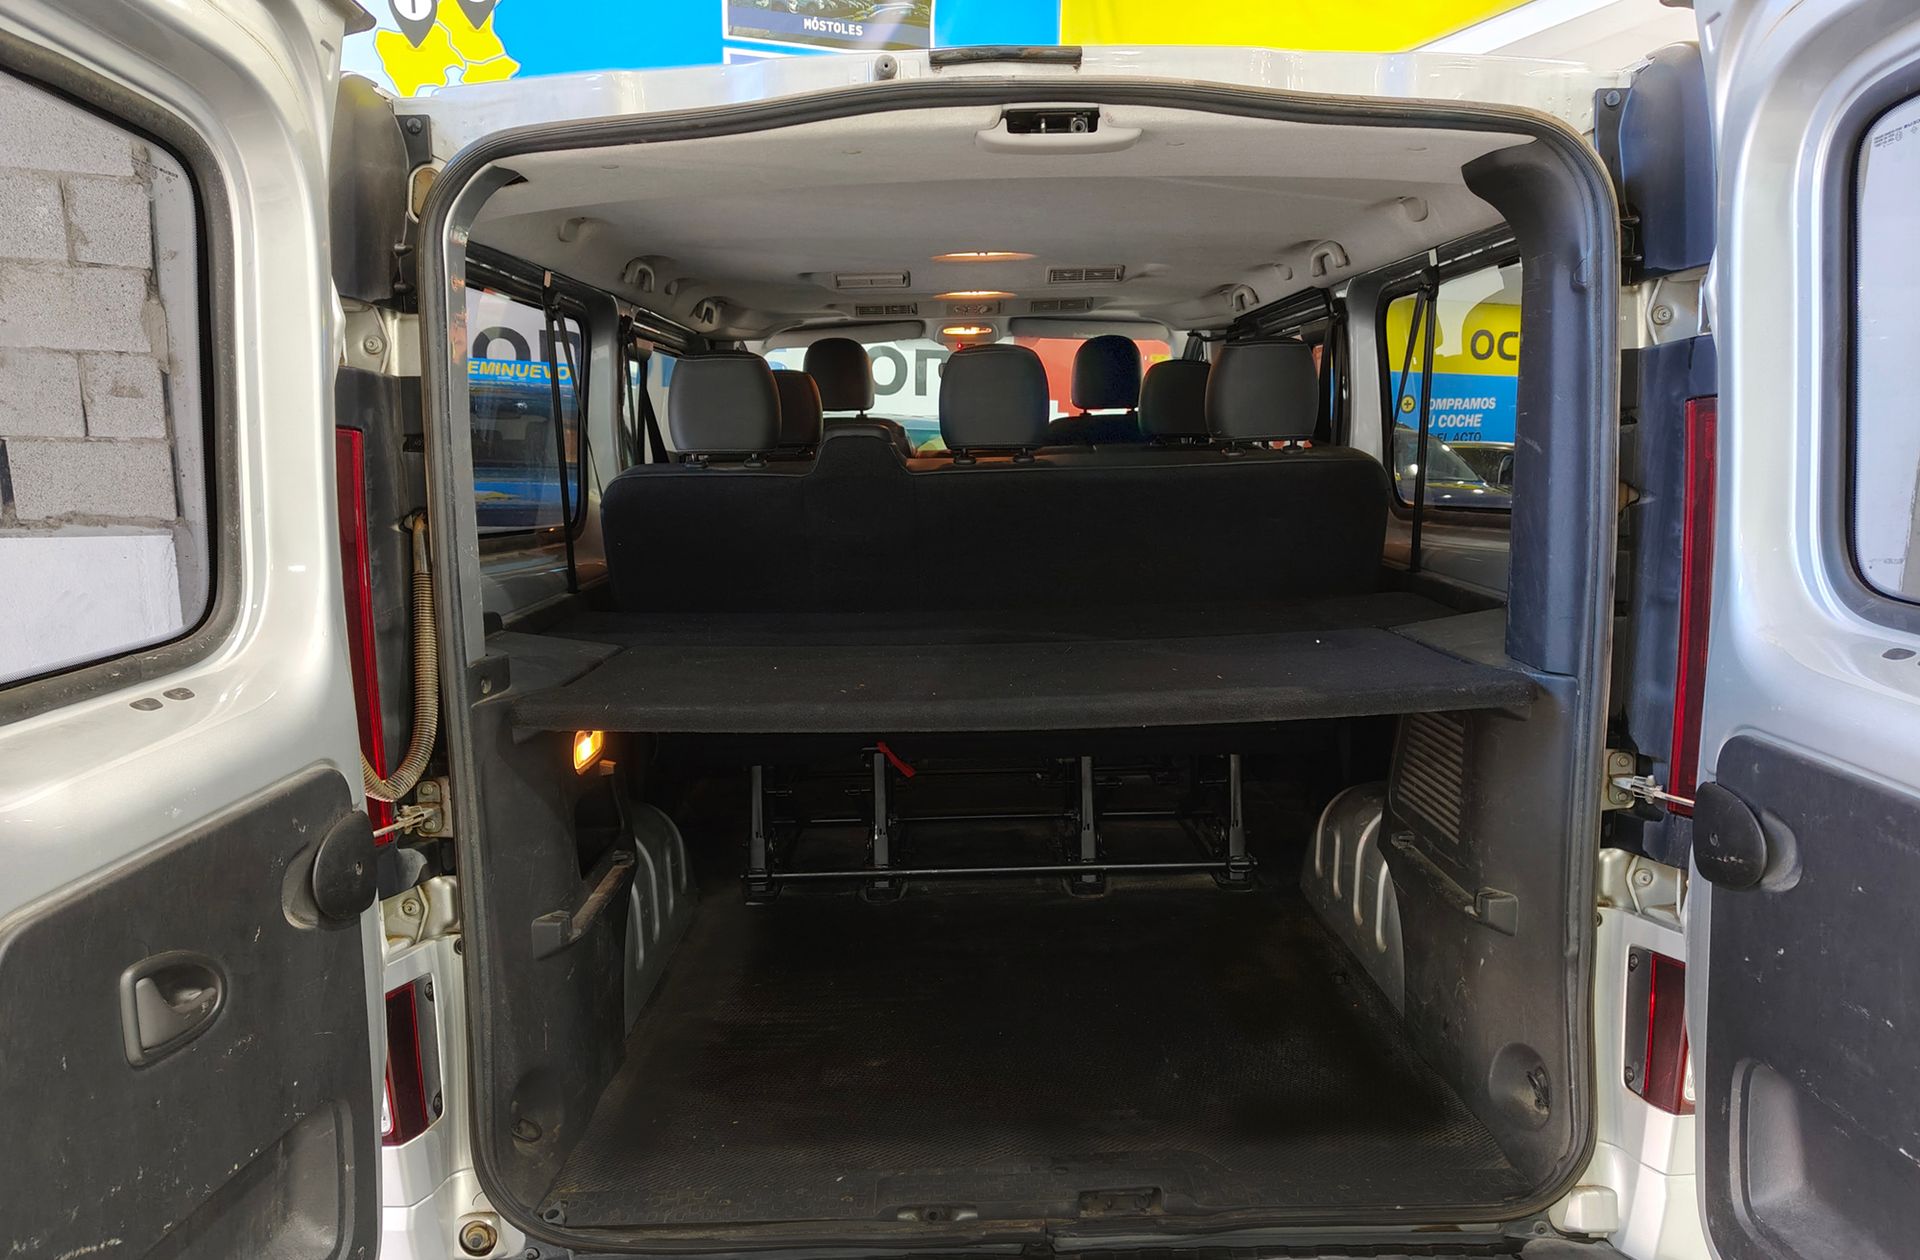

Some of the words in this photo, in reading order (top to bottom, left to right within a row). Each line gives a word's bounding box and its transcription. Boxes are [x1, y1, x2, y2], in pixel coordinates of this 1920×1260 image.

[803, 16, 863, 36] MÓSTOLES
[1430, 397, 1496, 411] OMPRAMOS
[1438, 413, 1483, 428] COCHE
[1453, 431, 1482, 442] ACTO
